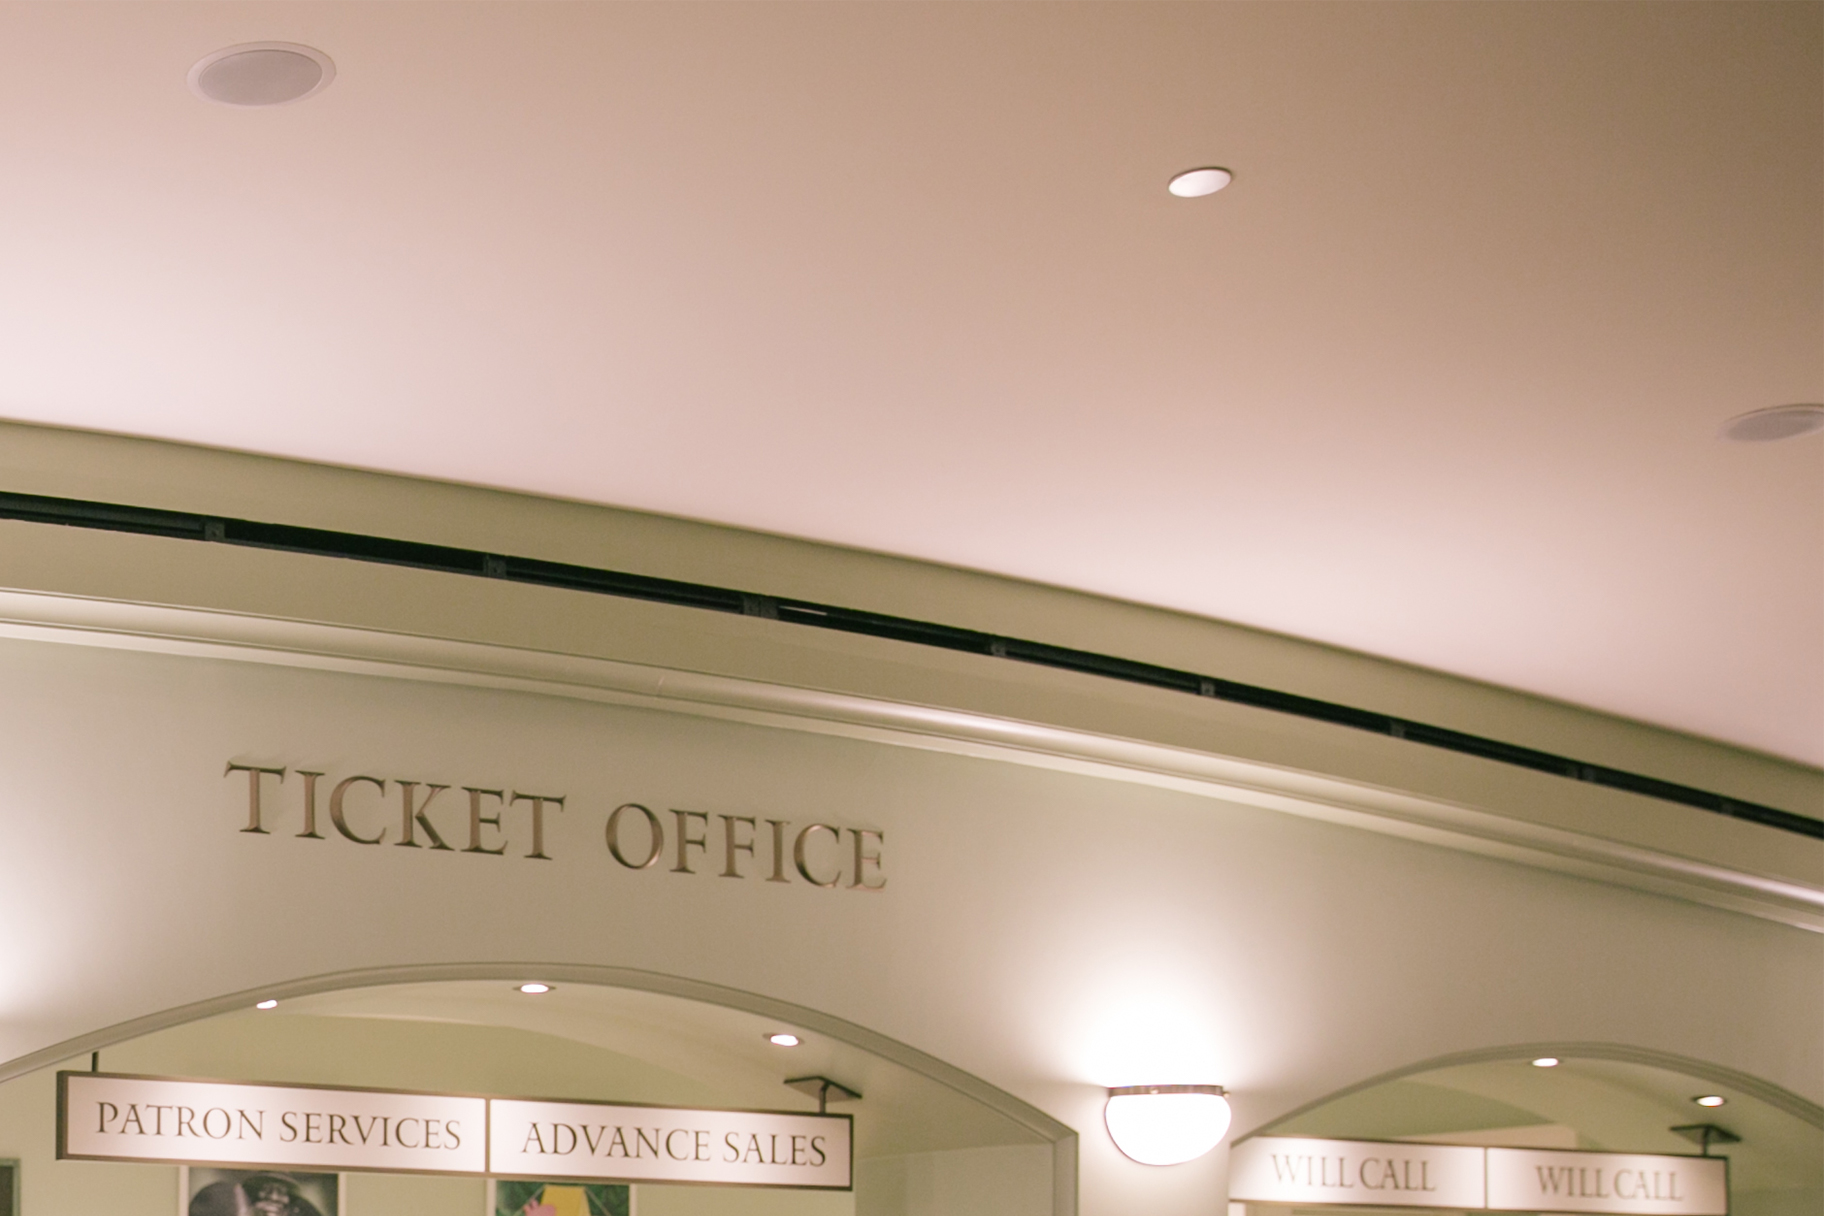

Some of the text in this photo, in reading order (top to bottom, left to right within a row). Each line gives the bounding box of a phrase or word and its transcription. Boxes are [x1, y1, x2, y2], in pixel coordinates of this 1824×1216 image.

[223, 759, 887, 891] TICKET OFFICE
[95, 1100, 463, 1151] PATRON SERVICES
[521, 1121, 828, 1168] ADVANCE SALES
[1270, 1153, 1439, 1193] WILL CALL
[1535, 1165, 1685, 1202] WILL CALL
